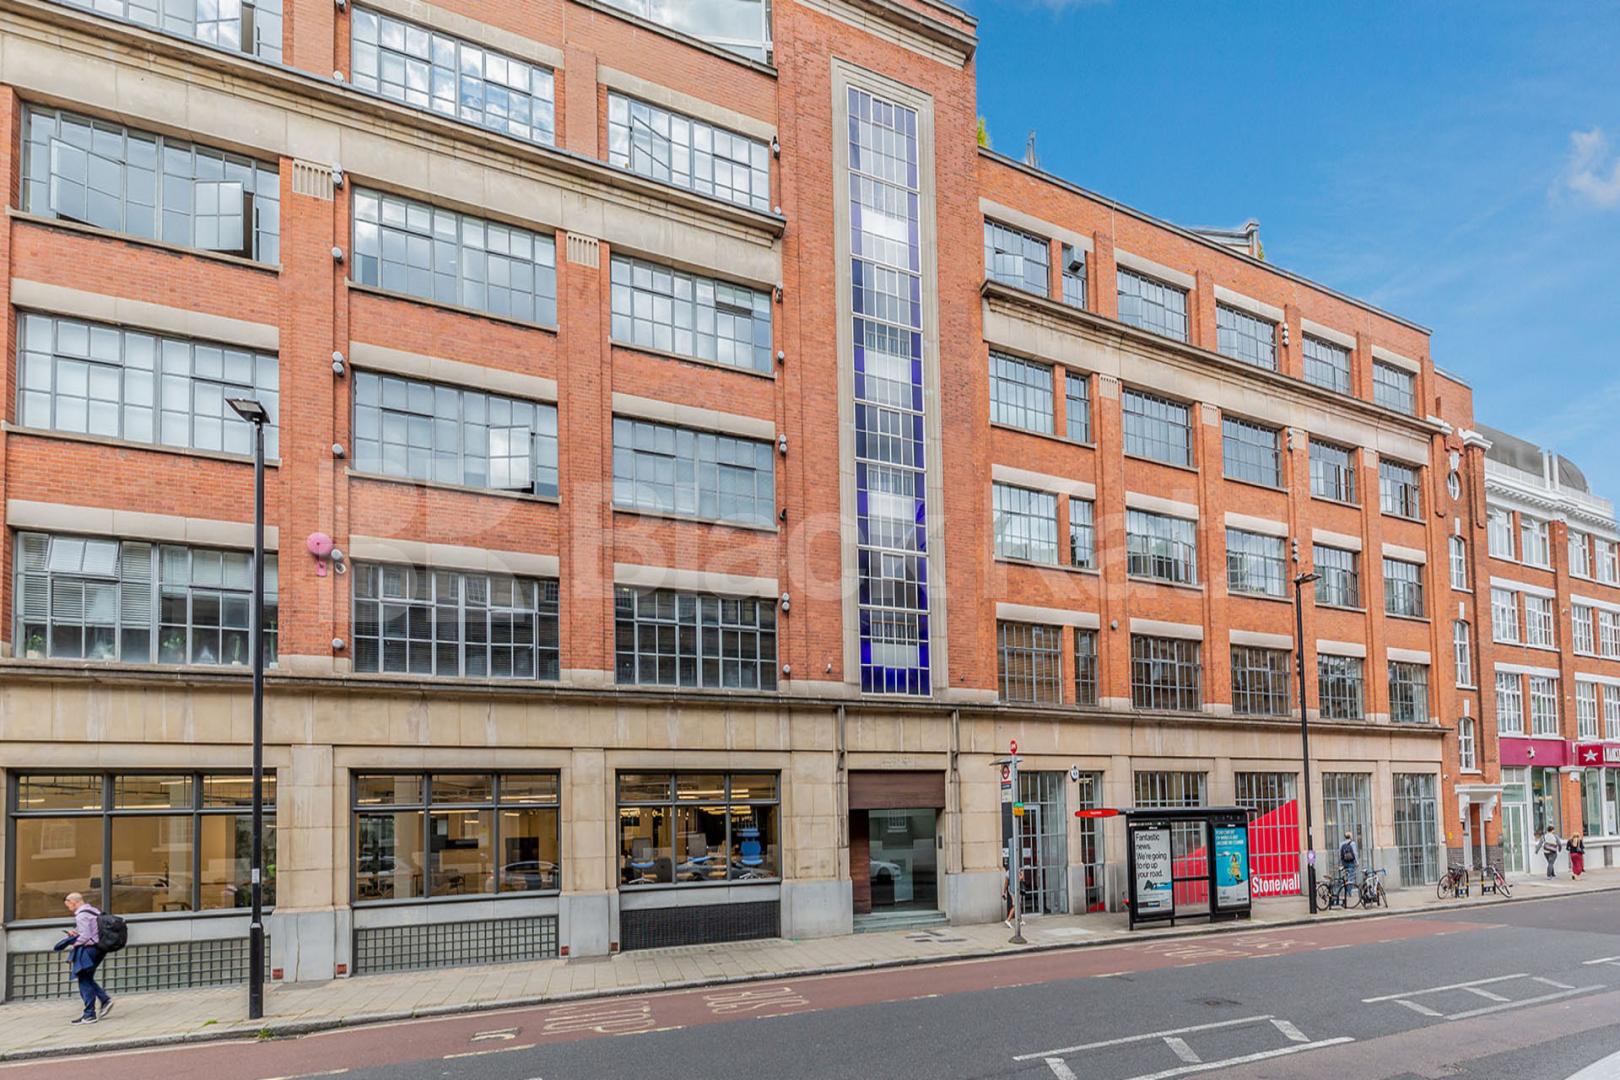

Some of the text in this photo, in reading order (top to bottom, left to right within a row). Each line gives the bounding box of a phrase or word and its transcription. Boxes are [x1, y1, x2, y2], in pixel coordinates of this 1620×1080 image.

[1135, 832, 1160, 841] Fantastic
[1137, 851, 1167, 861] We're going
[1151, 862, 1158, 870] up
[1137, 871, 1148, 880] your
[1252, 872, 1300, 893] Stonewall
